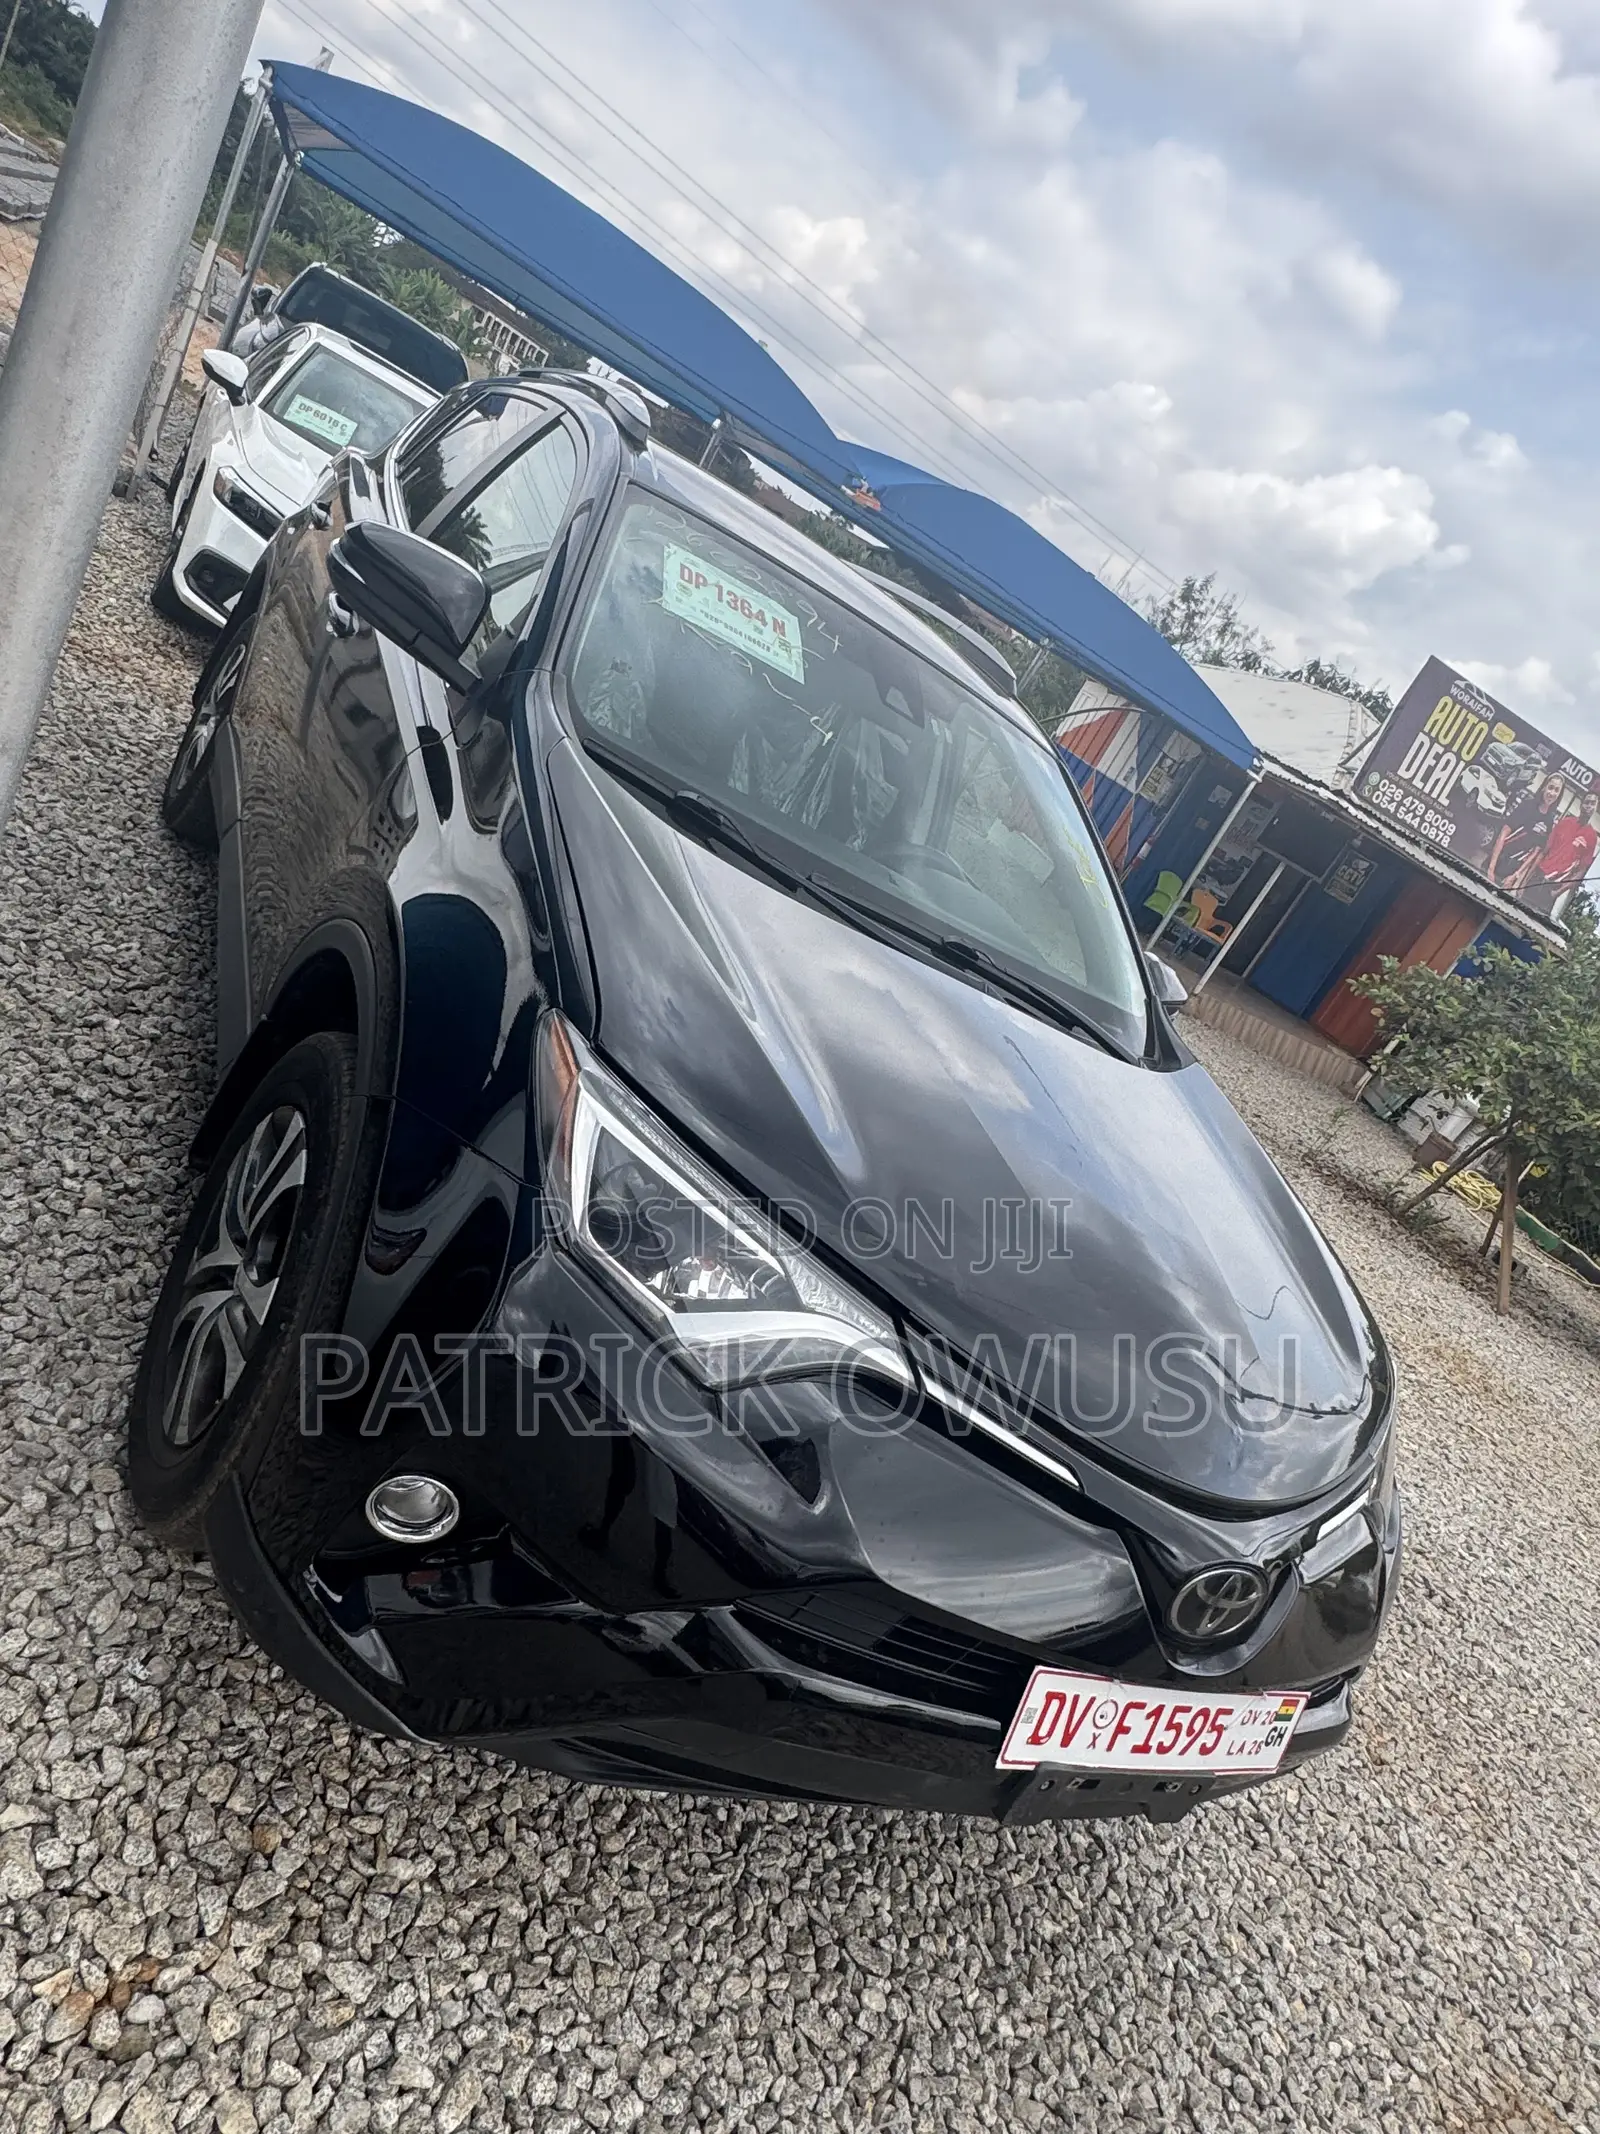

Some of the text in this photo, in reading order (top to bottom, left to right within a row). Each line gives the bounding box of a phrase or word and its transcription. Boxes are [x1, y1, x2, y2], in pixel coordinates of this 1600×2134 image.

[298, 403, 313, 413] DP
[340, 423, 348, 431] C
[680, 562, 708, 589] DP
[715, 582, 768, 628] 1364
[772, 615, 787, 638] N
[1423, 696, 1489, 762] AUTO
[1397, 731, 1466, 807] DEAL
[1560, 758, 1593, 785] AUTO
[1372, 791, 1451, 848] 054 544 0878
[1379, 779, 1404, 801] 026
[1403, 796, 1426, 816] 479
[1425, 809, 1456, 835] 8009
[1026, 1690, 1234, 1755] DV F1595
[1226, 1740, 1246, 1756] LA
[1264, 1726, 1288, 1748] GH
